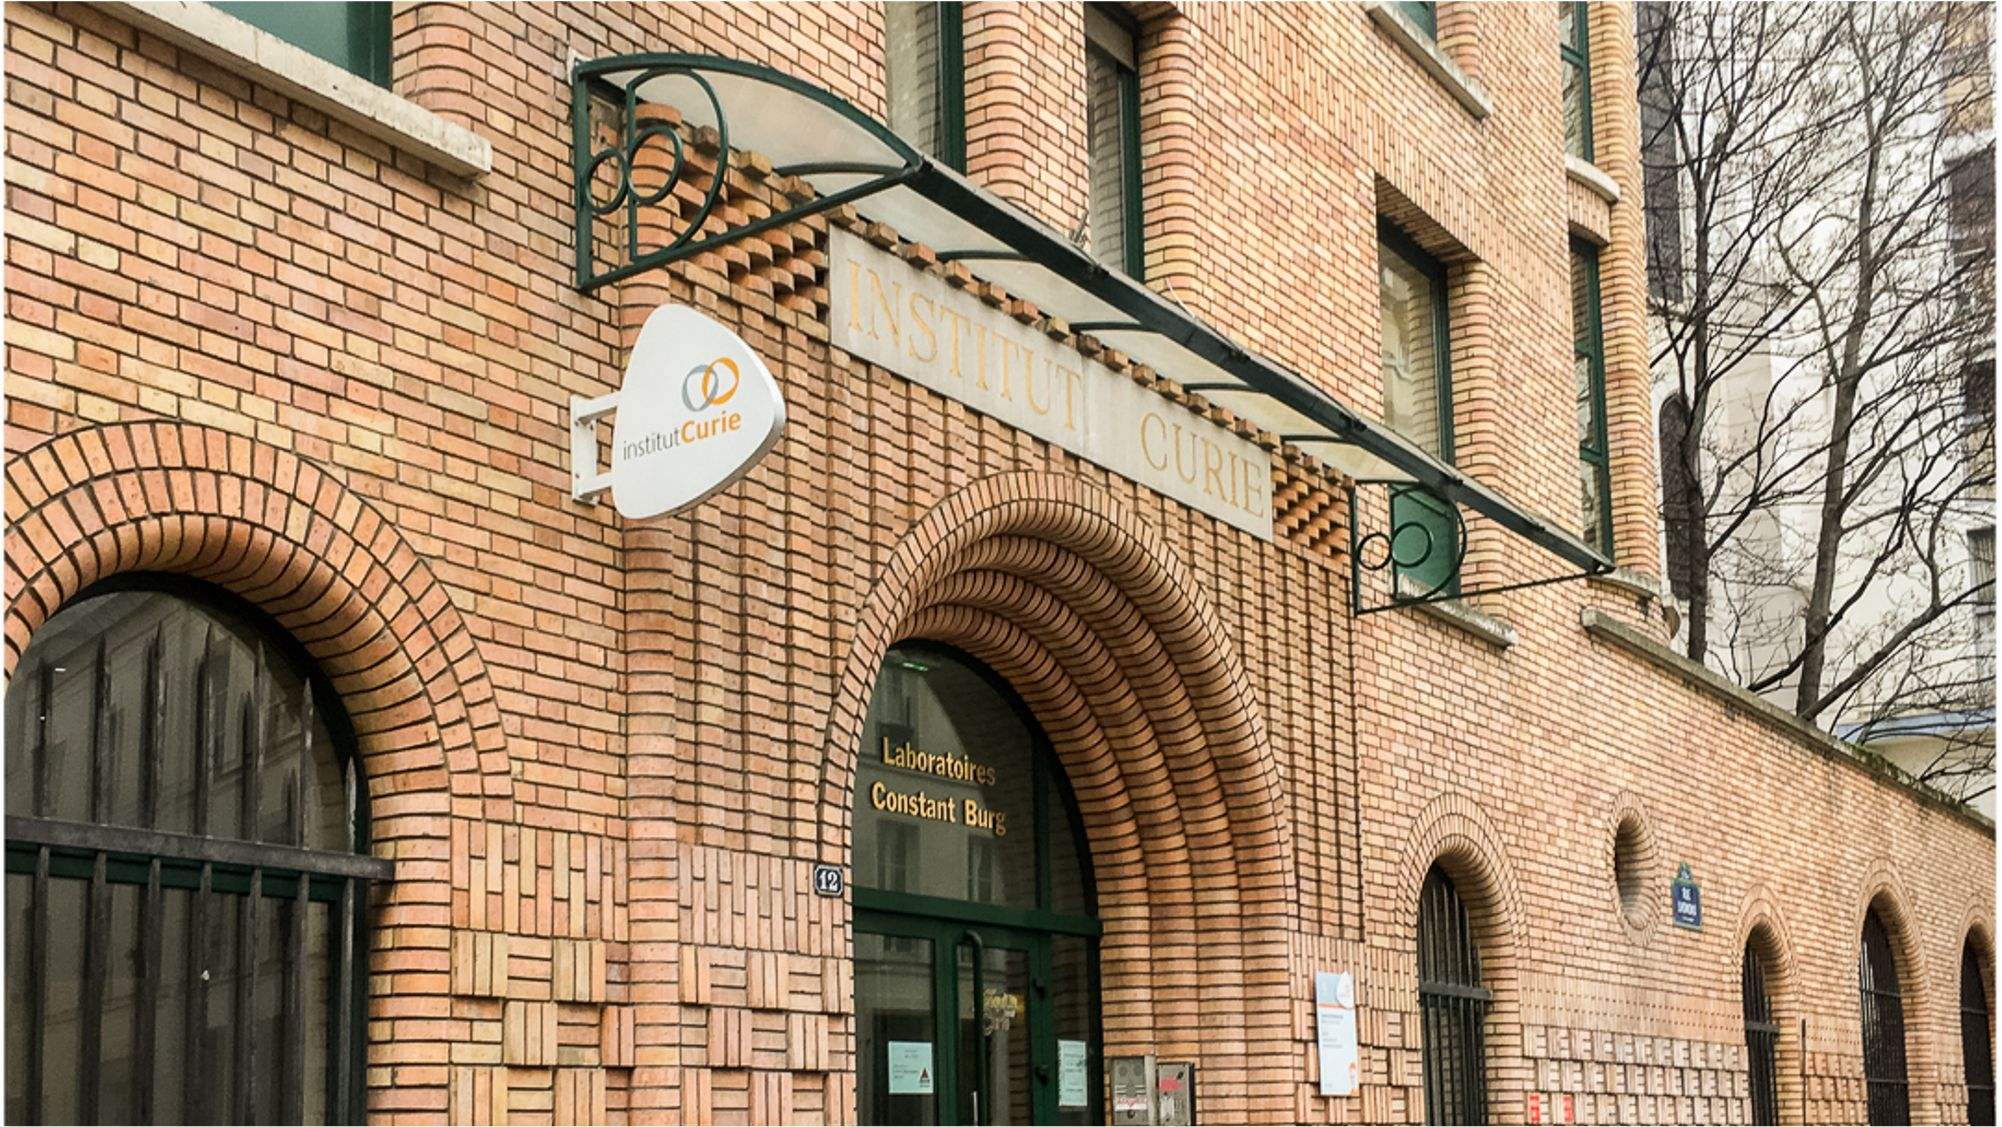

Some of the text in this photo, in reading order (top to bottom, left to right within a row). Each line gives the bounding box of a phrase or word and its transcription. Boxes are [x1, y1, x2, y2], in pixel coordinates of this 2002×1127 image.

[847, 259, 1265, 519] INSTITUT CURIE
[623, 410, 742, 461] institutCurie
[882, 737, 996, 786] Laboratoires
[871, 781, 1007, 836] Constant Burg
[818, 869, 839, 892] 12
